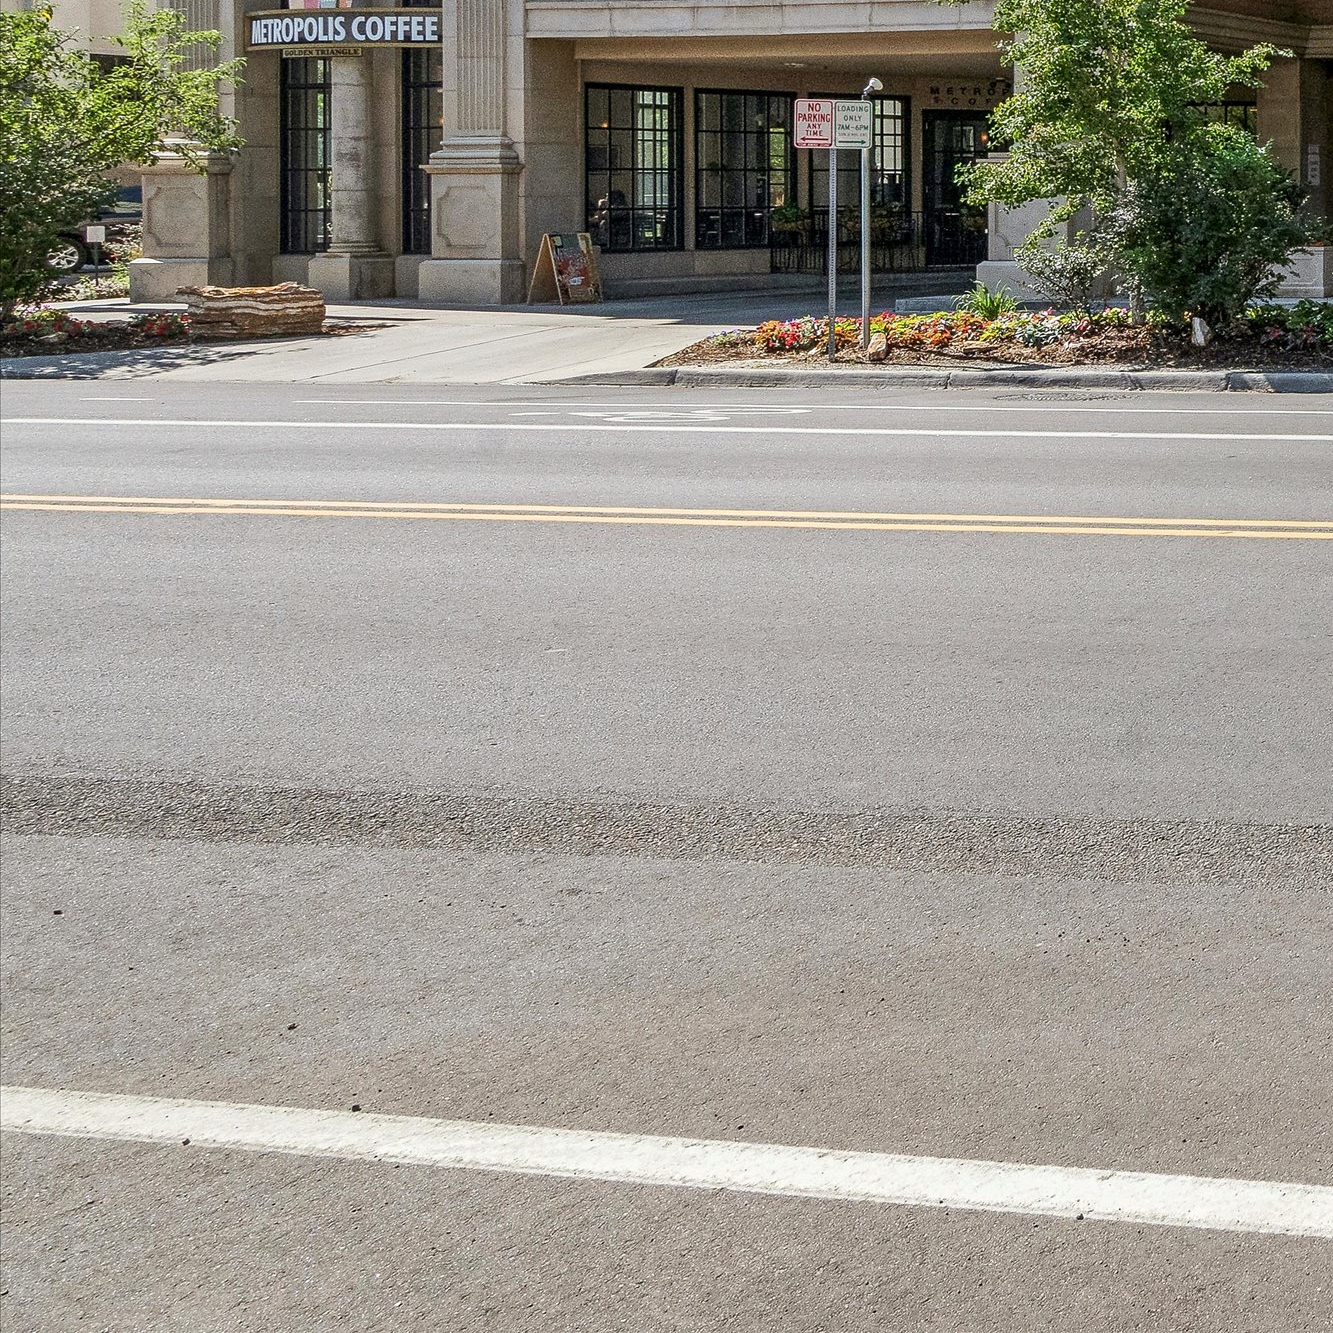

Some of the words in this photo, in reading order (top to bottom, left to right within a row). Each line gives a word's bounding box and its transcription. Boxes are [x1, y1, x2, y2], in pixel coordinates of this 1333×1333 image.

[251, 16, 346, 44] METROPOLIS
[351, 16, 439, 41] COFFEE
[284, 49, 314, 57] GOLDEN
[315, 48, 360, 56] TRIANGLE
[930, 86, 1009, 95] METROP
[807, 103, 821, 112] NO
[798, 113, 831, 122] PARKING
